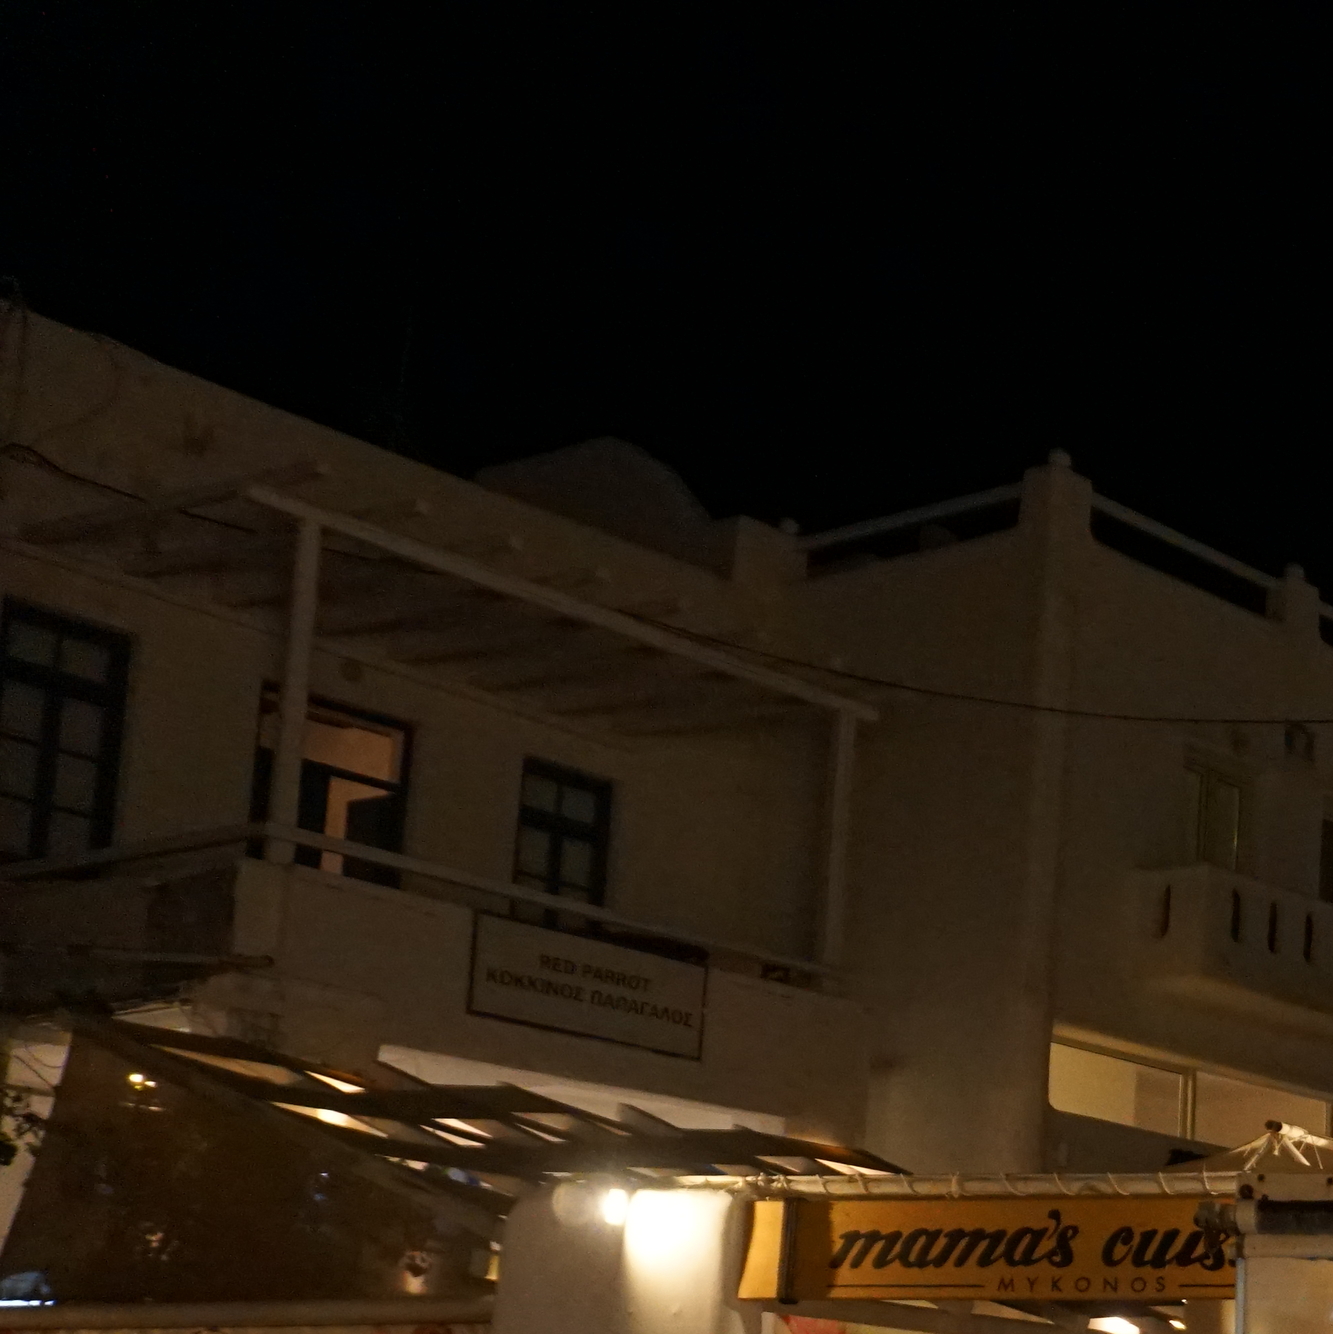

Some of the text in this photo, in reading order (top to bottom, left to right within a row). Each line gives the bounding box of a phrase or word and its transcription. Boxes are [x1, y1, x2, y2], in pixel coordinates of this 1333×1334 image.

[486, 967, 693, 1028] ΚΟΚΚΙΝΟΣ ΠΑΠΑΓΑΛΟΣ
[539, 954, 652, 993] RED PARROT
[828, 1209, 1080, 1269] mama's
[998, 1276, 1167, 1293] MYKONOS
